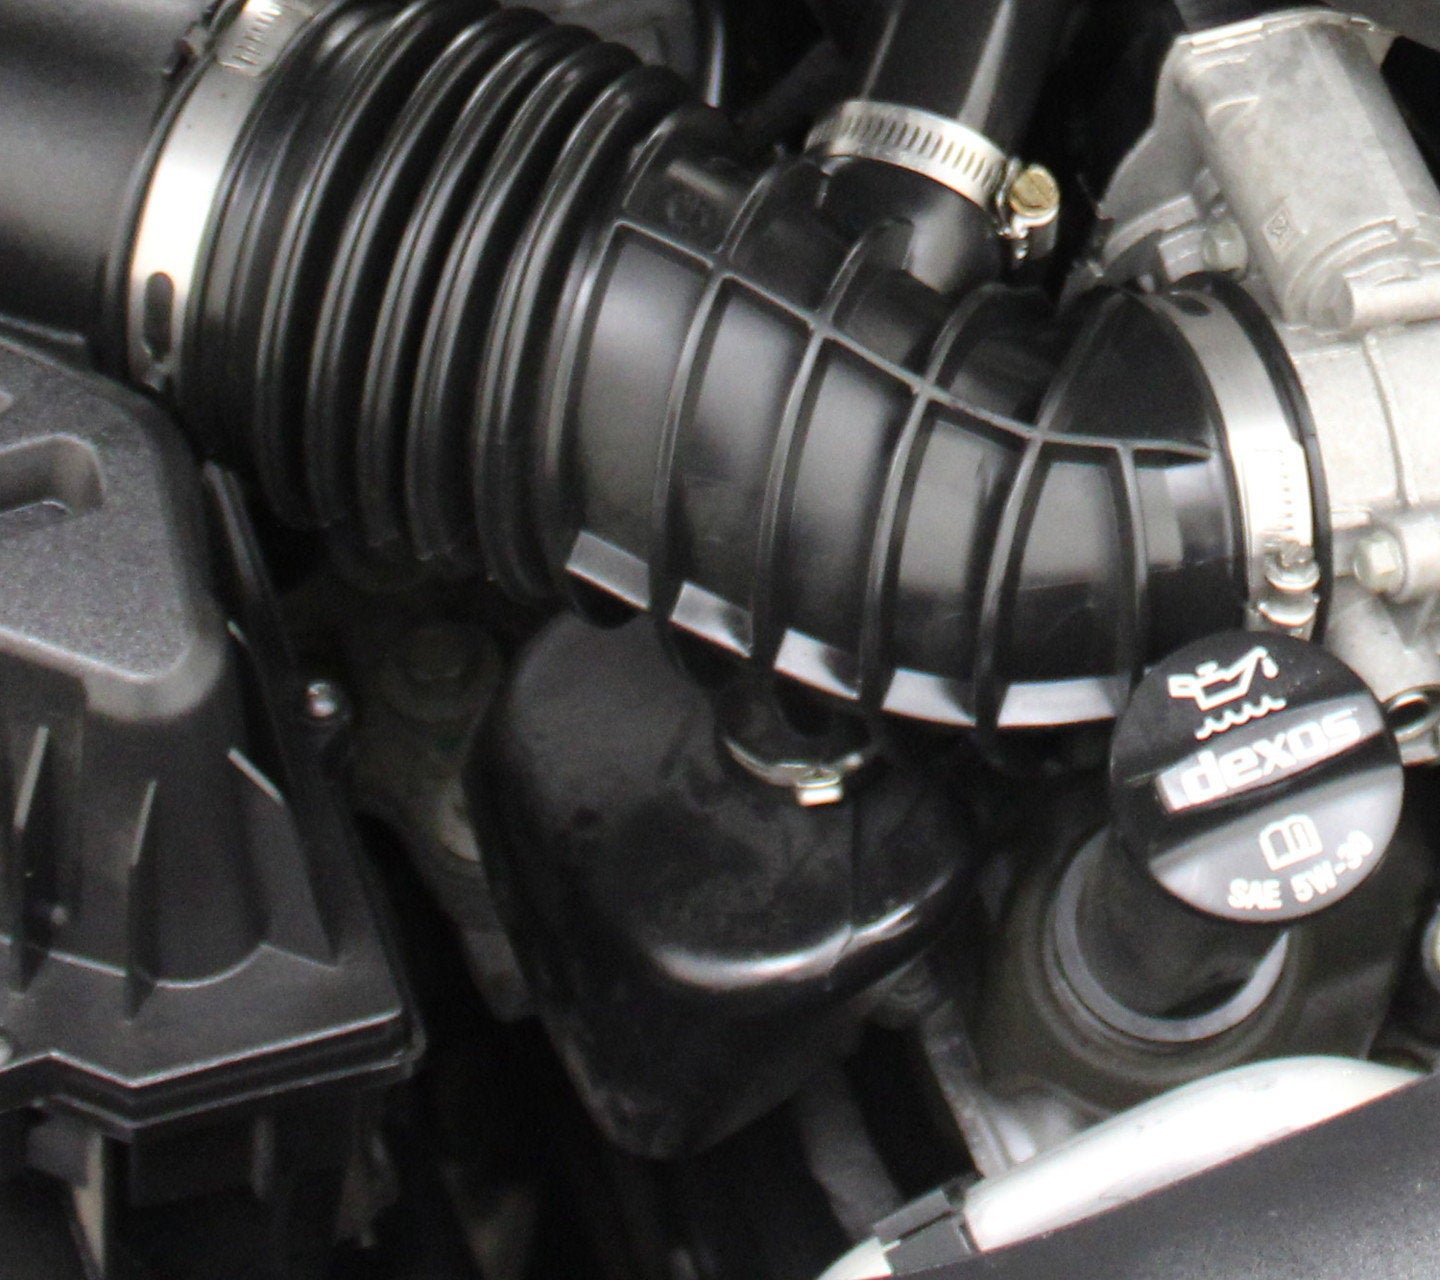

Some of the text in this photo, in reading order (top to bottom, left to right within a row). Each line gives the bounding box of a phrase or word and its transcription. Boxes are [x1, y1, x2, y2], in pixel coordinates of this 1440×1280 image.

[1180, 708, 1361, 805] dexos
[1228, 830, 1374, 910] SAE 5W-30
